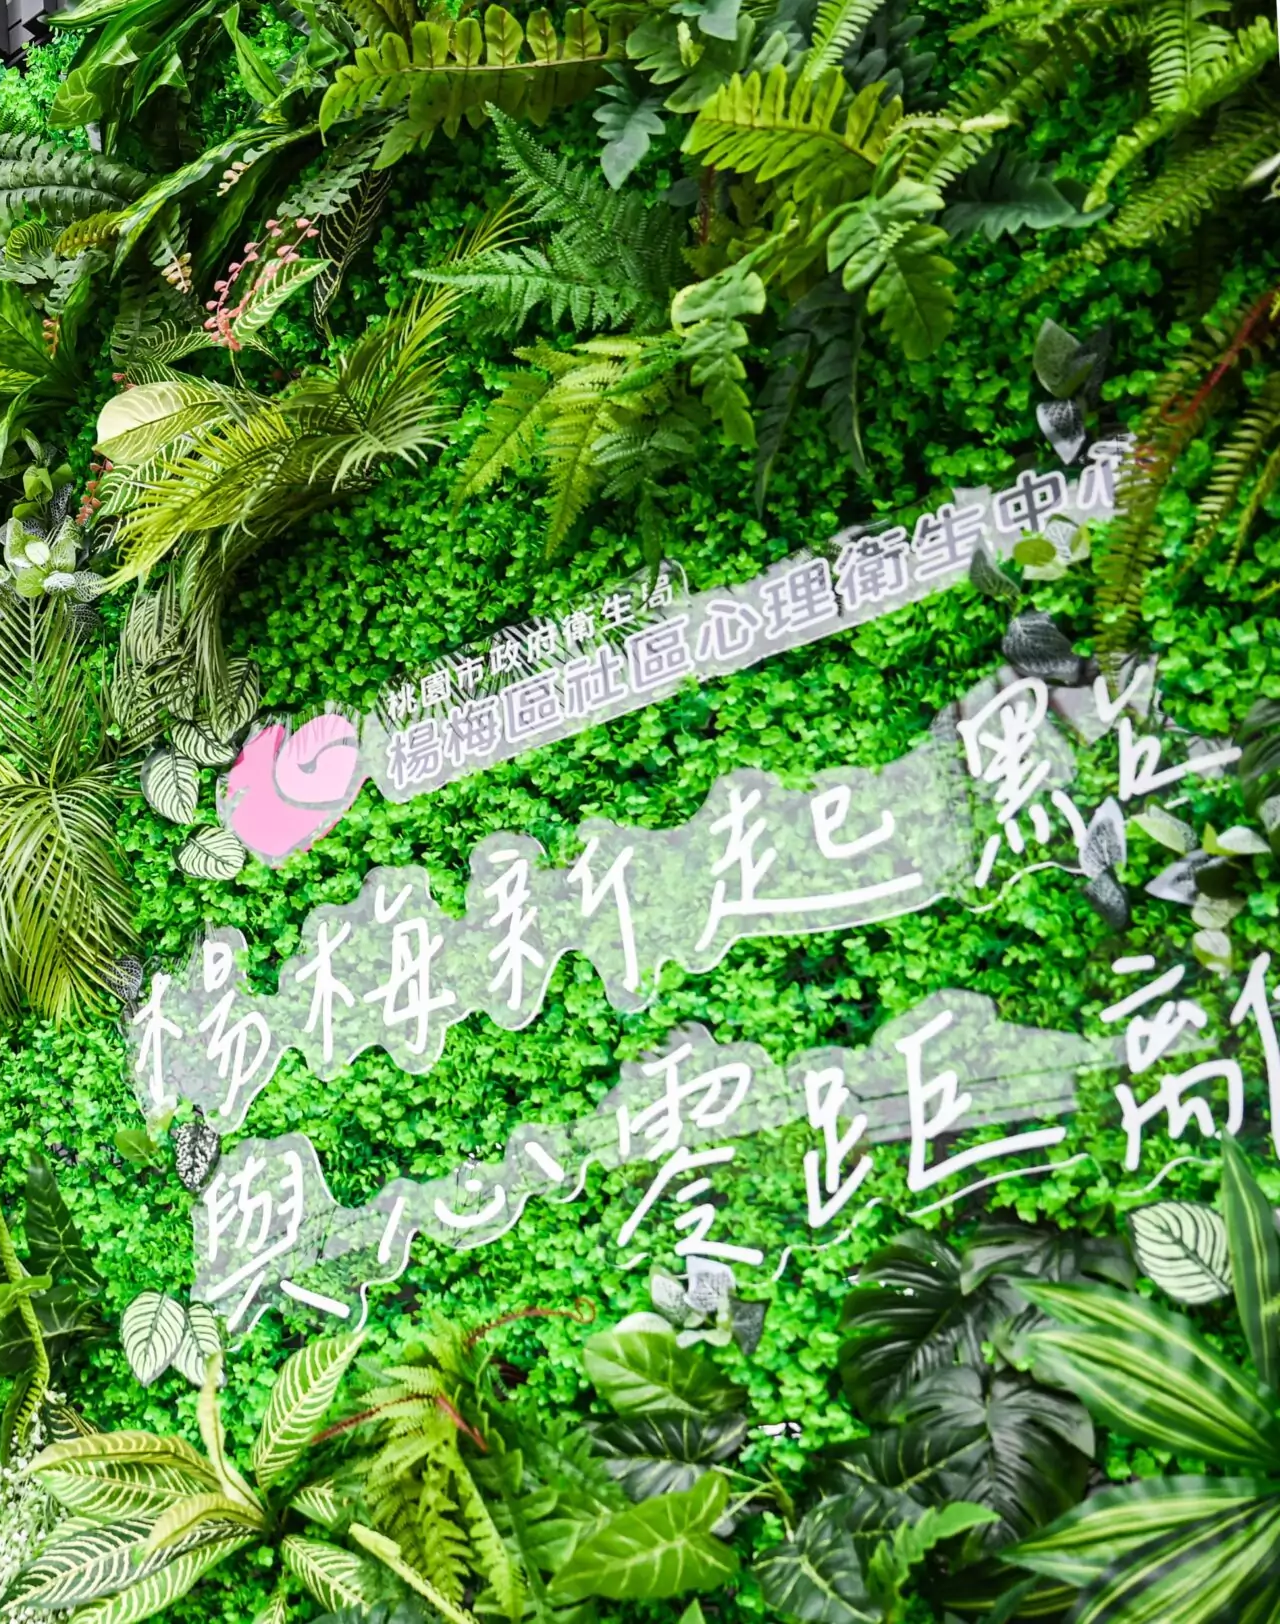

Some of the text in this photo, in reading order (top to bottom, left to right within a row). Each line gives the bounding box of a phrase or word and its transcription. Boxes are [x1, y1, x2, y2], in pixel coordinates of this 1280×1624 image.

[387, 574, 672, 720] 桃園市政府衛生局
[132, 664, 1243, 1118] 楊梅新起點
